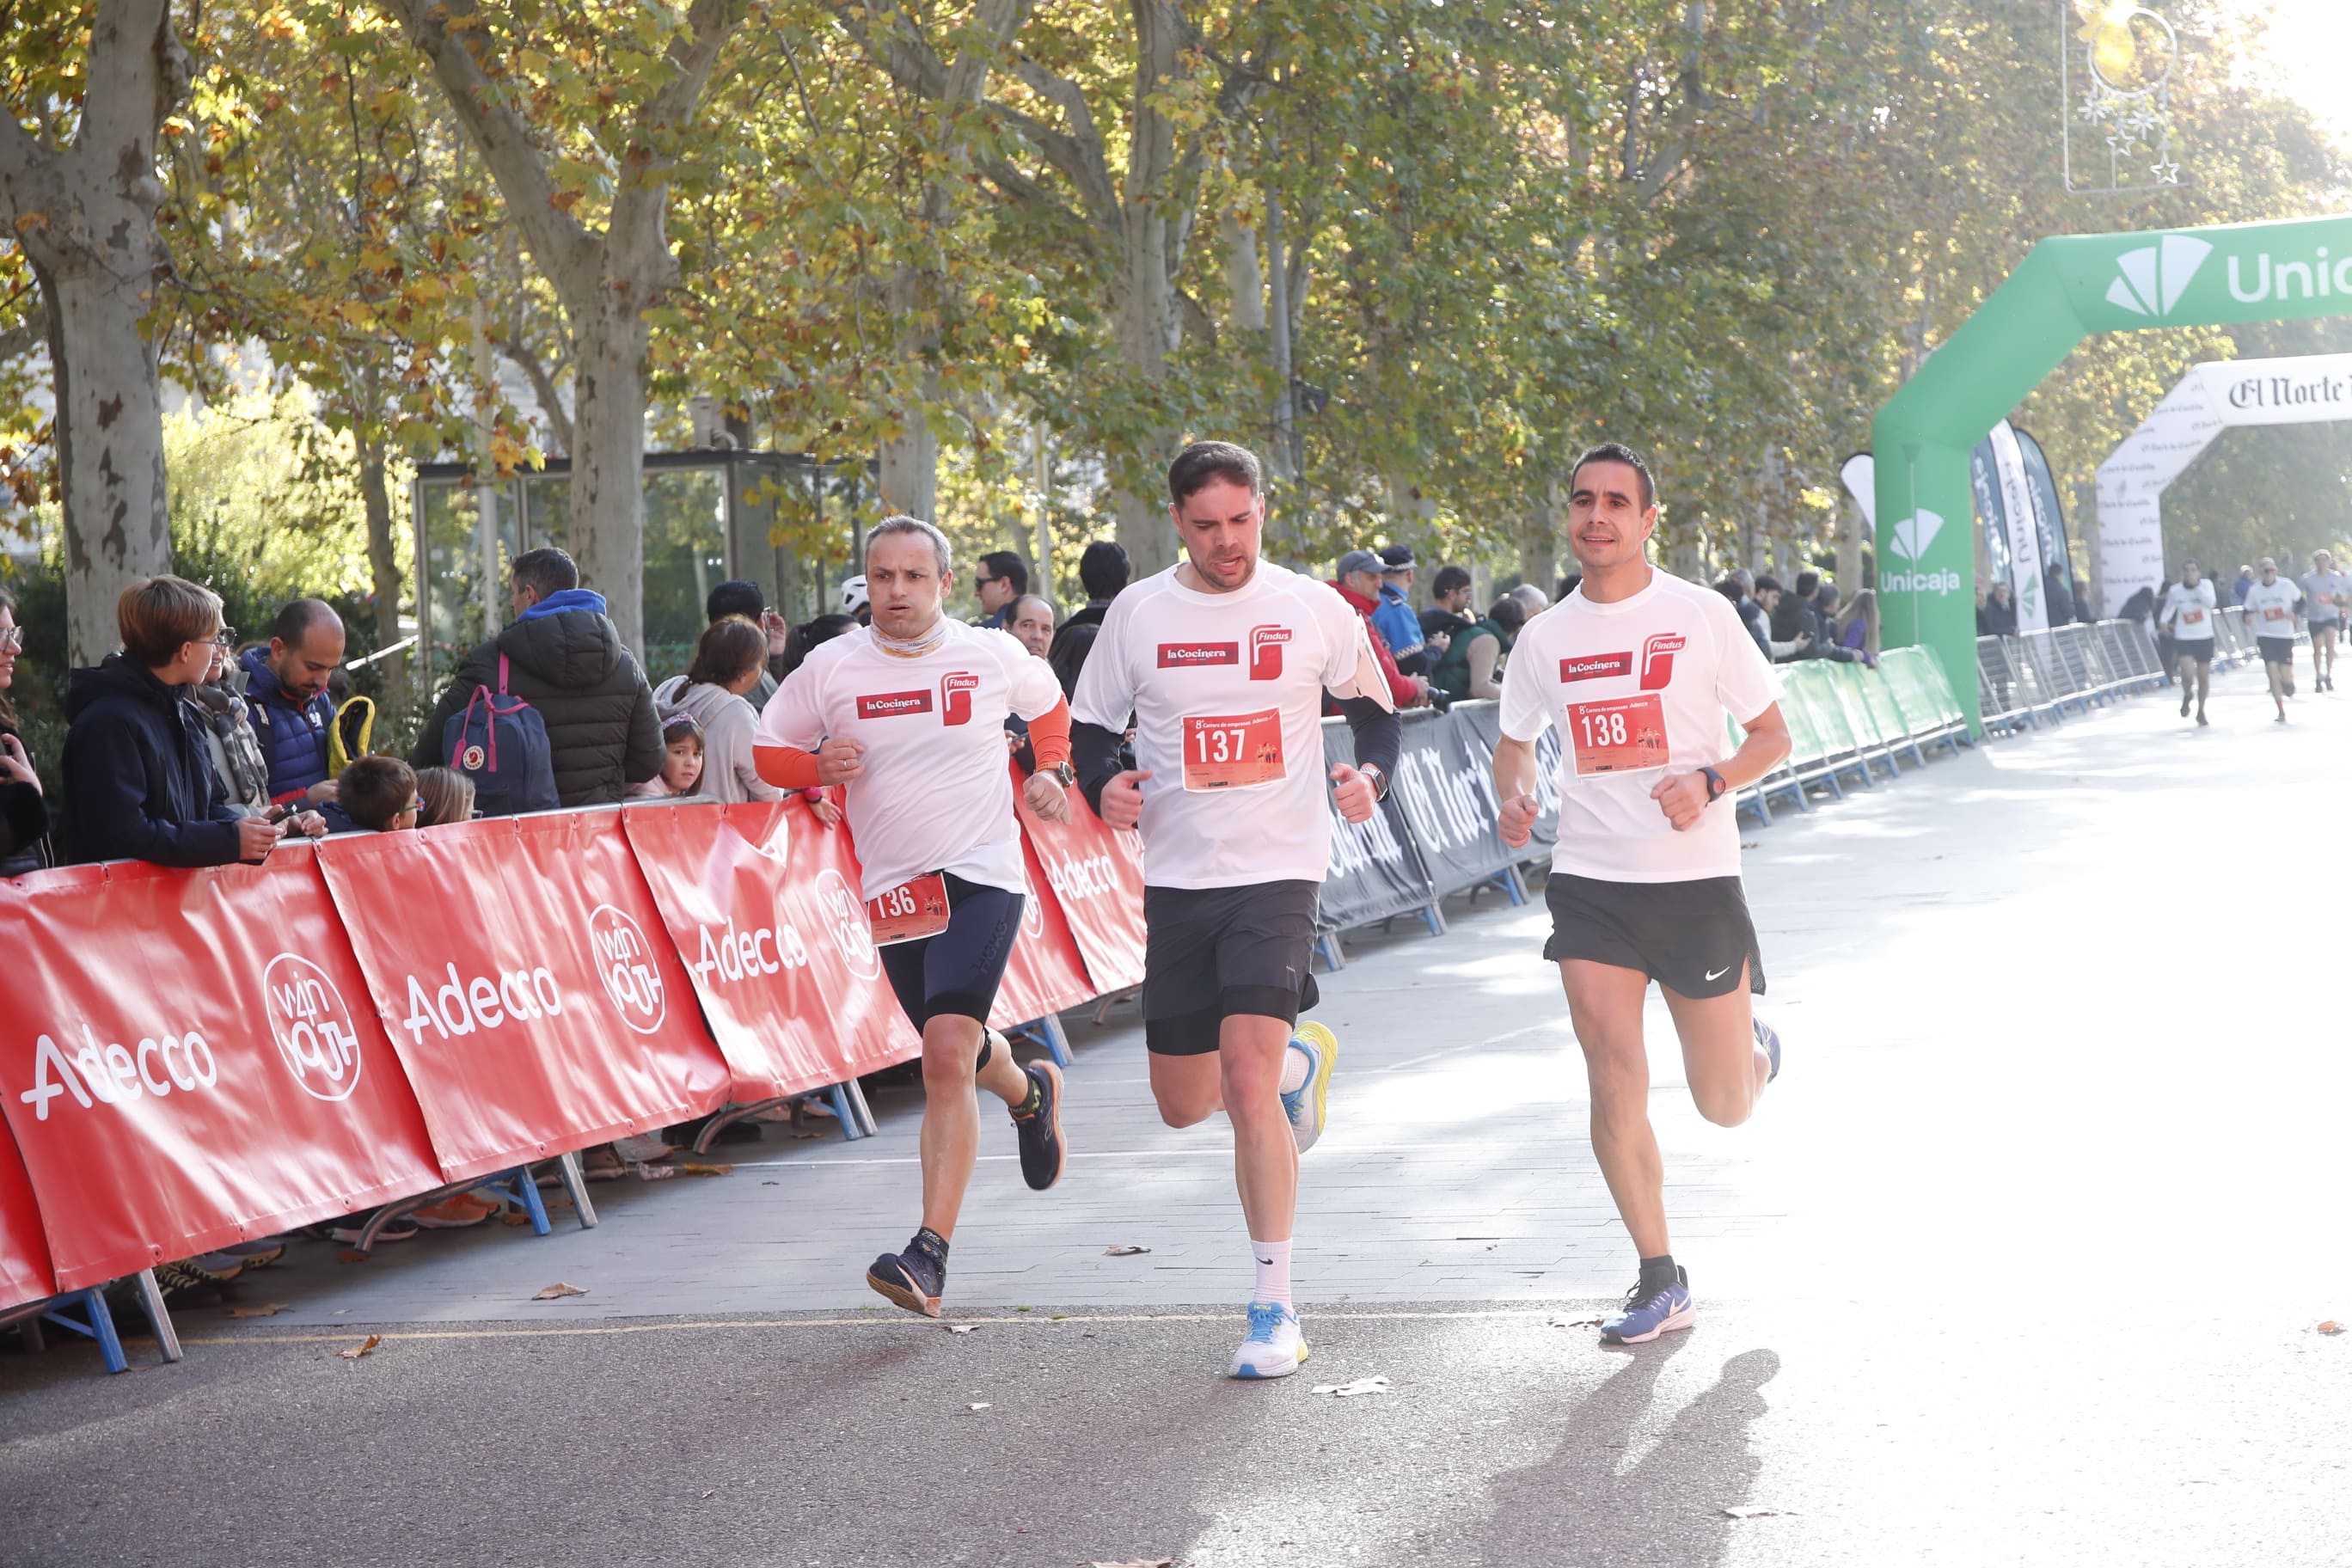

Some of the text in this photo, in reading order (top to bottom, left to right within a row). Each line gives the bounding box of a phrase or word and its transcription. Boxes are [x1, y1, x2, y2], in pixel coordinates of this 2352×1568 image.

[2229, 377, 2263, 408] El
[2270, 375, 2343, 406] Norte
[1880, 567, 1961, 597] Unicaja
[1259, 631, 1289, 641] Findus
[1651, 640, 1683, 650] Findus
[949, 678, 977, 687] Findus
[1196, 728, 1246, 763] 137
[1581, 713, 1628, 747] 138
[1052, 848, 1118, 901] Adecco
[876, 886, 917, 918] 136
[694, 915, 808, 987] Adecco
[403, 961, 562, 1045] Adecco
[21, 1023, 217, 1121] Adecco
